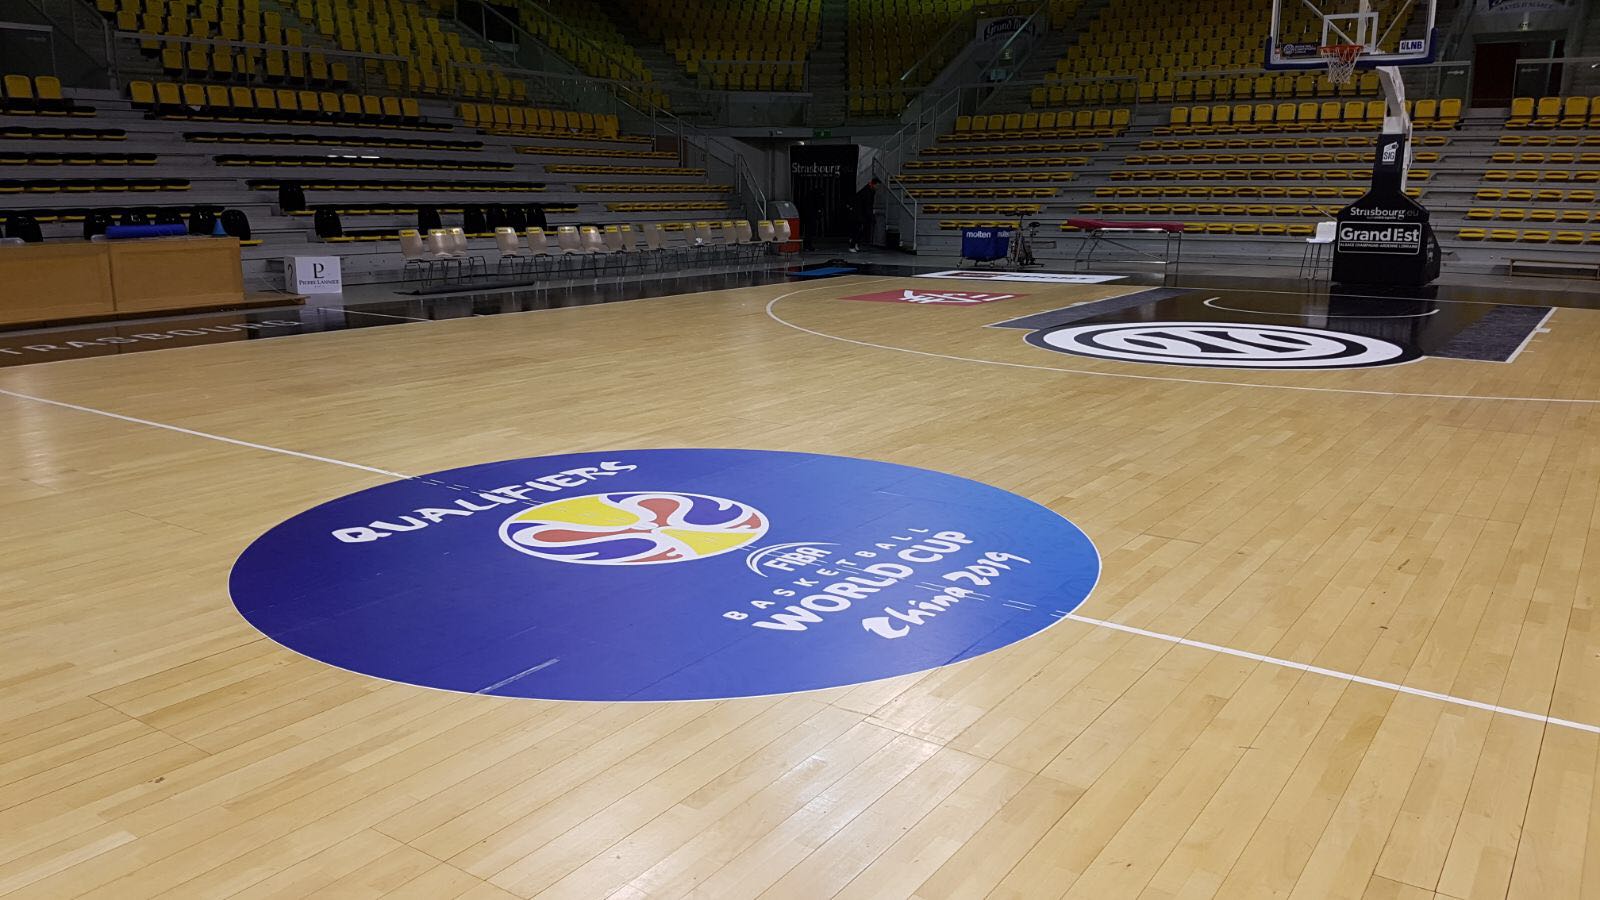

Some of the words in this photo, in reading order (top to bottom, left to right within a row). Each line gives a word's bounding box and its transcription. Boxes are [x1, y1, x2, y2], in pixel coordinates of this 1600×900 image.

[966, 230, 991, 239] molten
[331, 460, 638, 544] QUALIFIERS
[722, 527, 930, 621] BASKETBALL
[752, 562, 915, 632] WORLD
[897, 530, 974, 563] CUP
[763, 546, 833, 573] FIBA
[862, 586, 975, 639] China
[942, 551, 1032, 586] 2019
